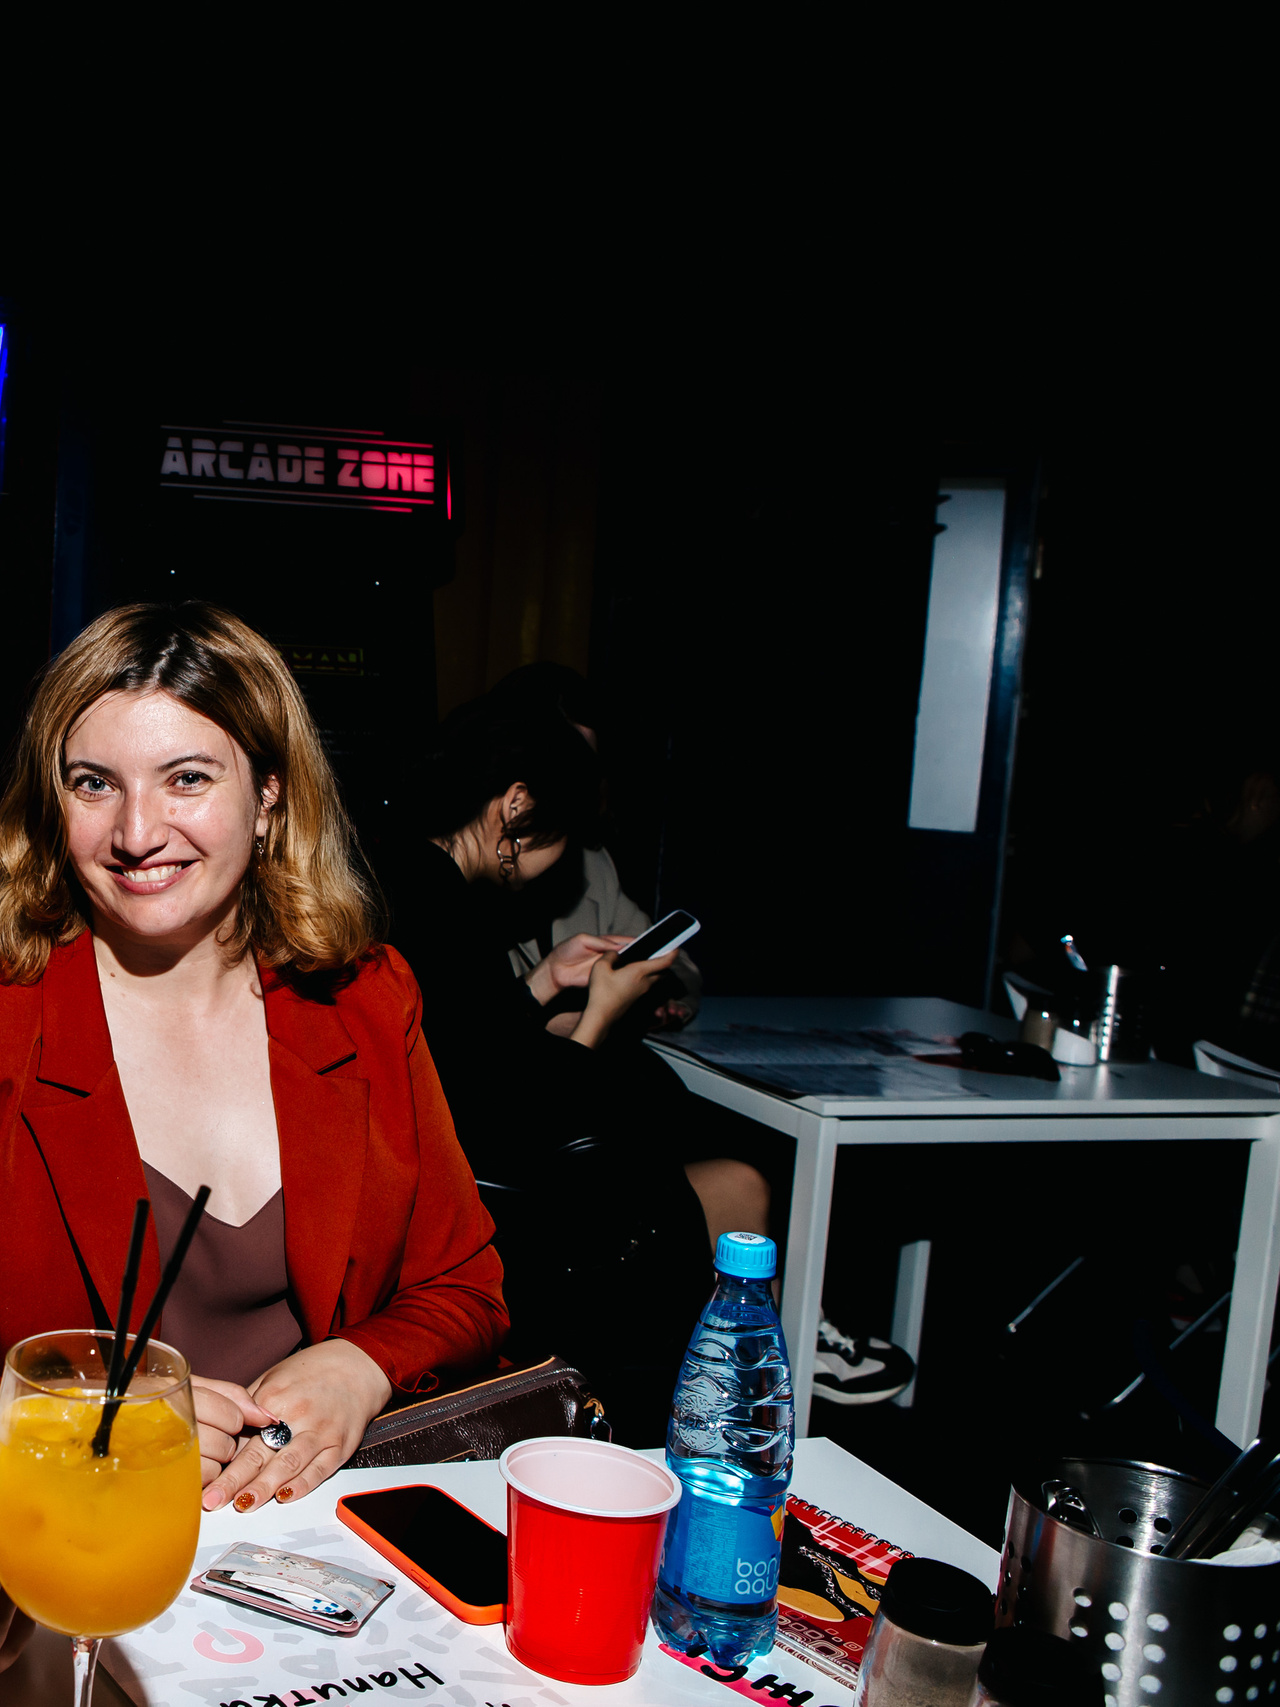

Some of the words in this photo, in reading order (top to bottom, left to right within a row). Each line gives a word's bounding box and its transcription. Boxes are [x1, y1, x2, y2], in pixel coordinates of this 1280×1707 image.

[160, 437, 325, 485] ARCADE
[337, 449, 434, 493] ZONE
[736, 1557, 778, 1578] bon
[734, 1574, 780, 1597] aqu
